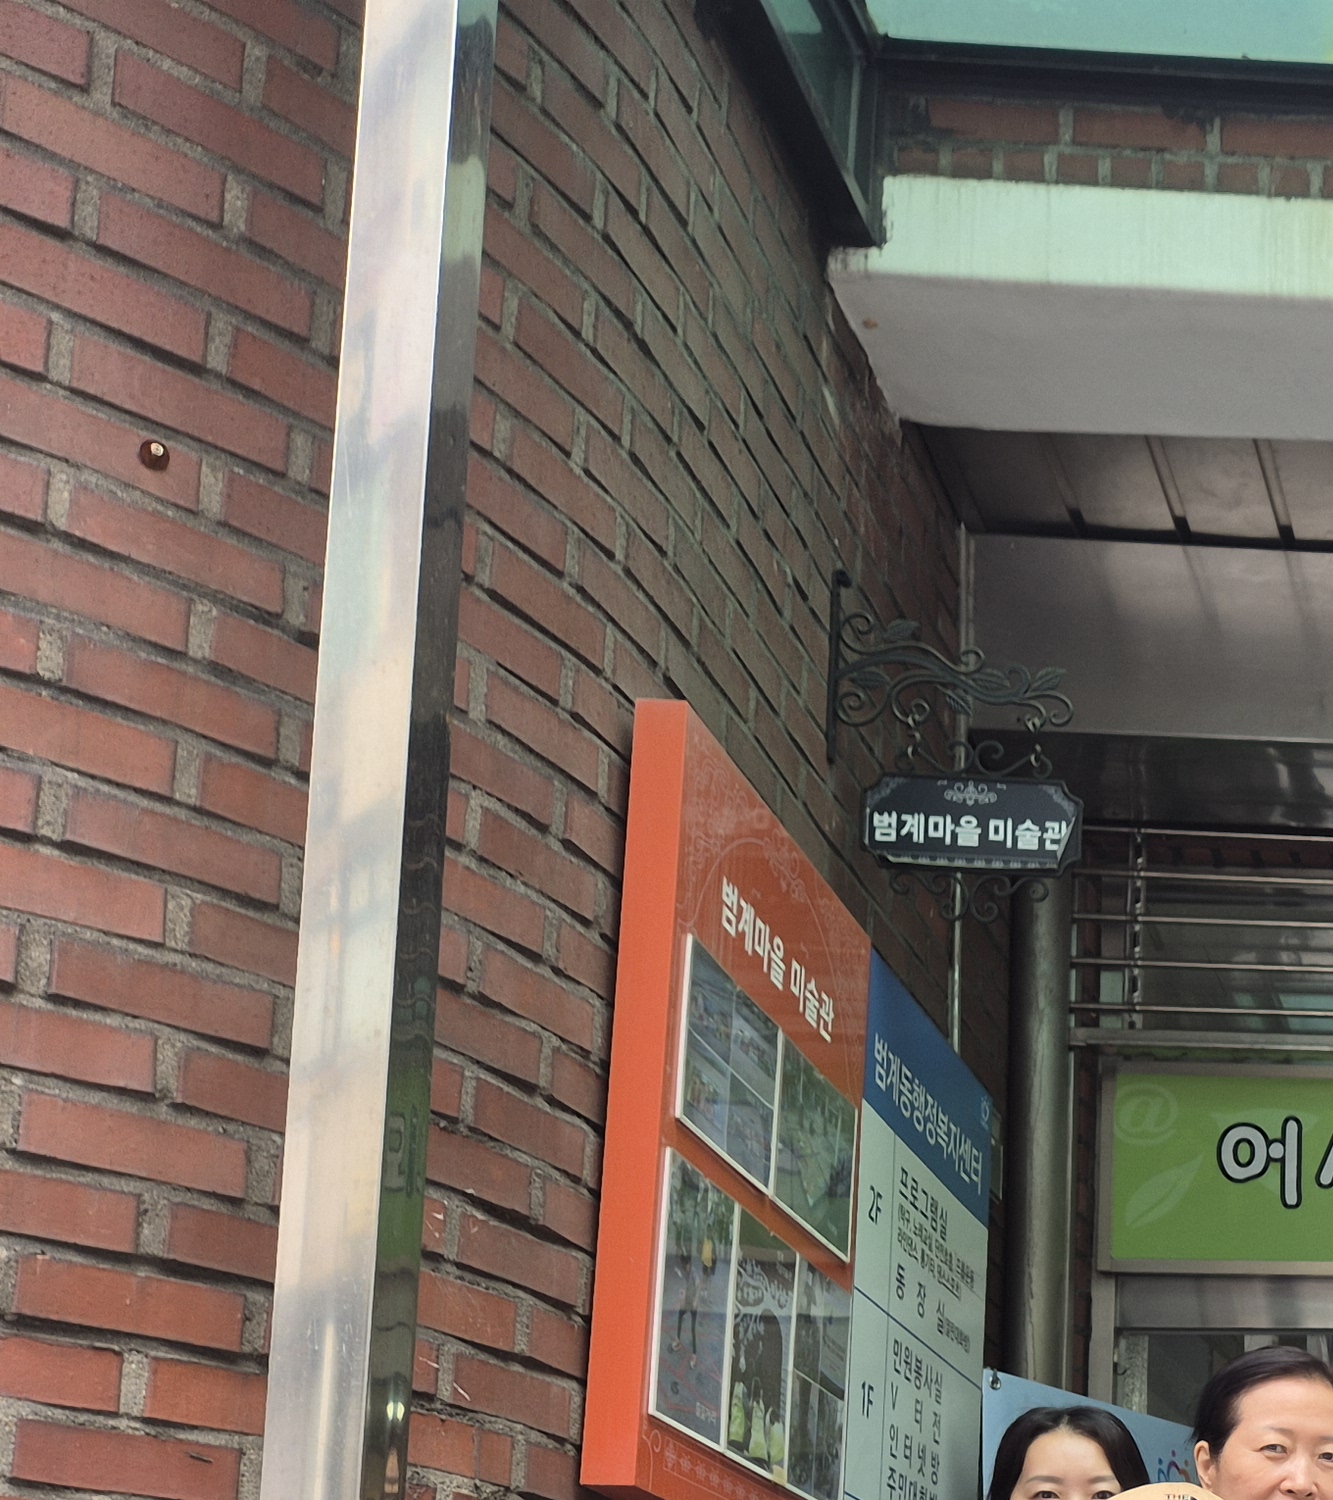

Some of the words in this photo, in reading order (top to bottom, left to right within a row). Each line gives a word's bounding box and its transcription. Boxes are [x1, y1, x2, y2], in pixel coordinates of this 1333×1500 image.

[873, 811, 982, 848] 범계마을
[988, 814, 1067, 852] 미술관
[721, 877, 786, 990] 범계마을
[790, 957, 835, 1043] 미술관
[873, 1033, 983, 1196] 범계동행정복지센터
[868, 1184, 882, 1228] 2F
[898, 1163, 947, 1242] 프로그램실
[860, 1379, 874, 1421] 1F
[891, 1336, 942, 1405] 민원봉사실
